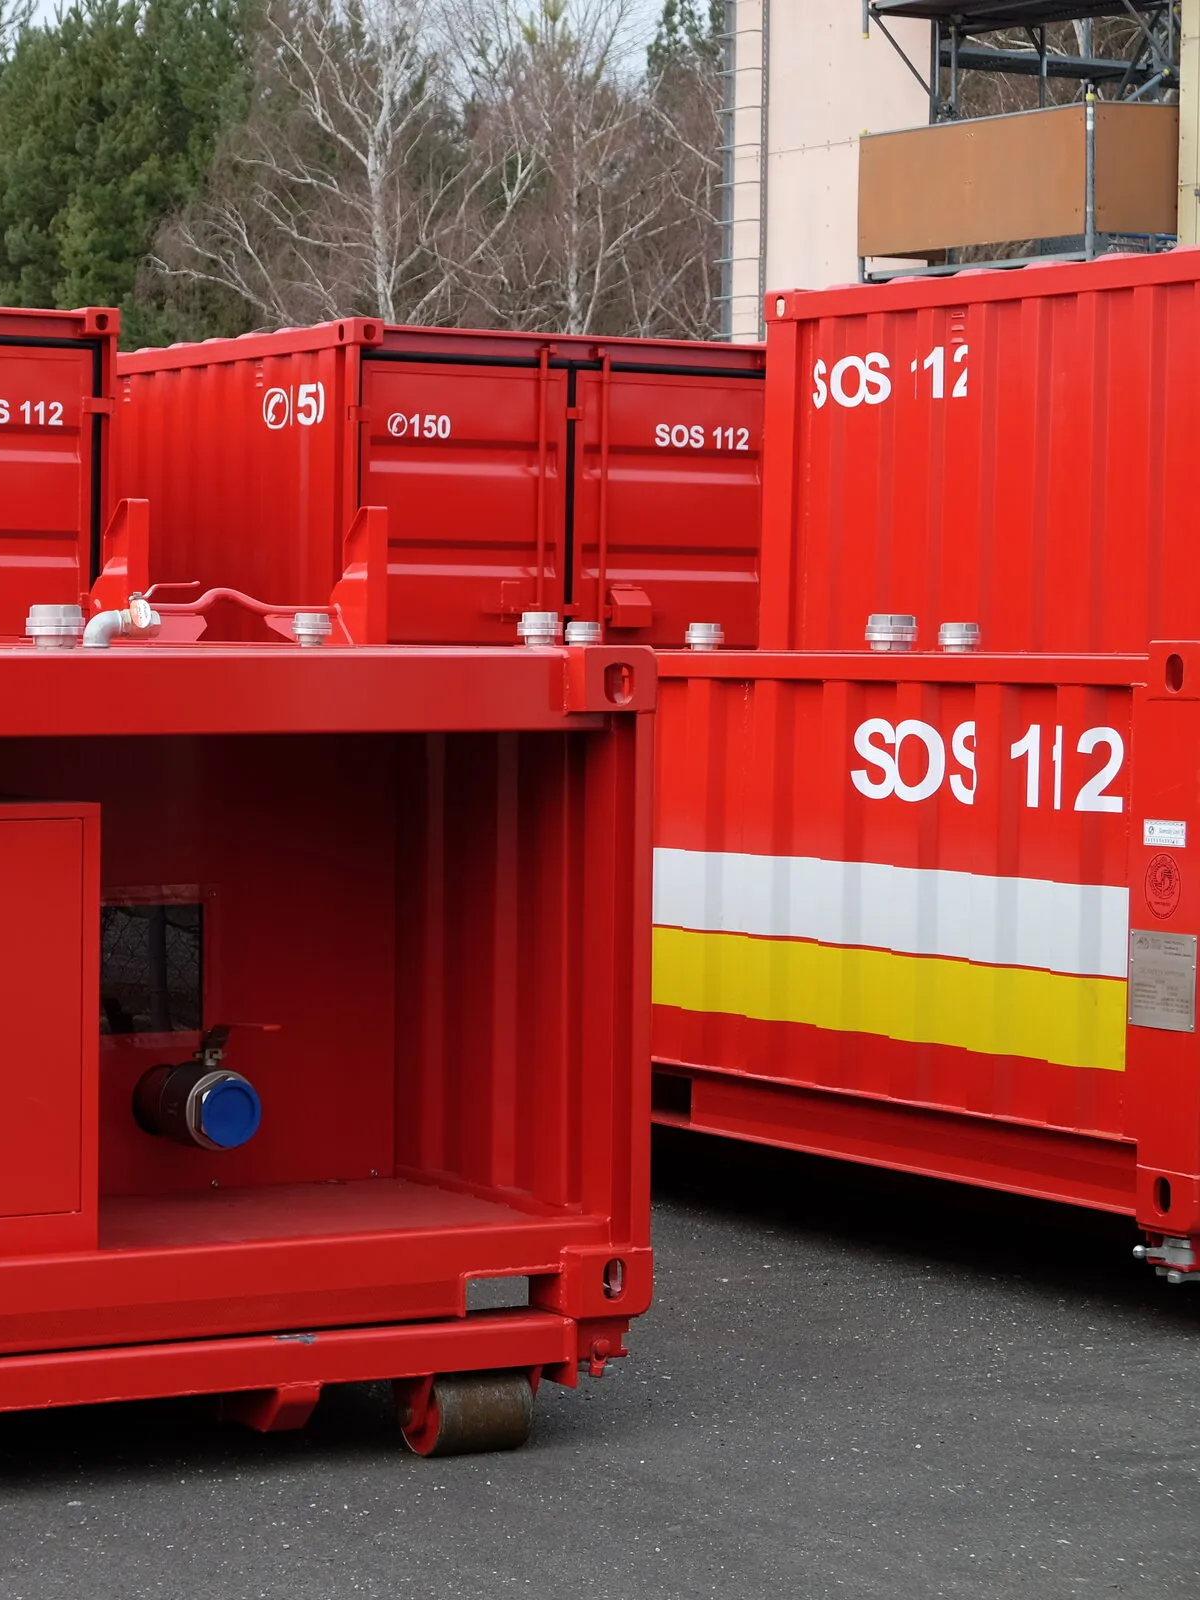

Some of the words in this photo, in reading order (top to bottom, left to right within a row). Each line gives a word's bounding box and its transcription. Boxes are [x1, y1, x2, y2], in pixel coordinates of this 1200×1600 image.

[19, 400, 64, 426] 112
[409, 413, 451, 439] 150
[654, 423, 705, 449] SOS
[712, 426, 749, 451] 112
[851, 717, 978, 805] SOS
